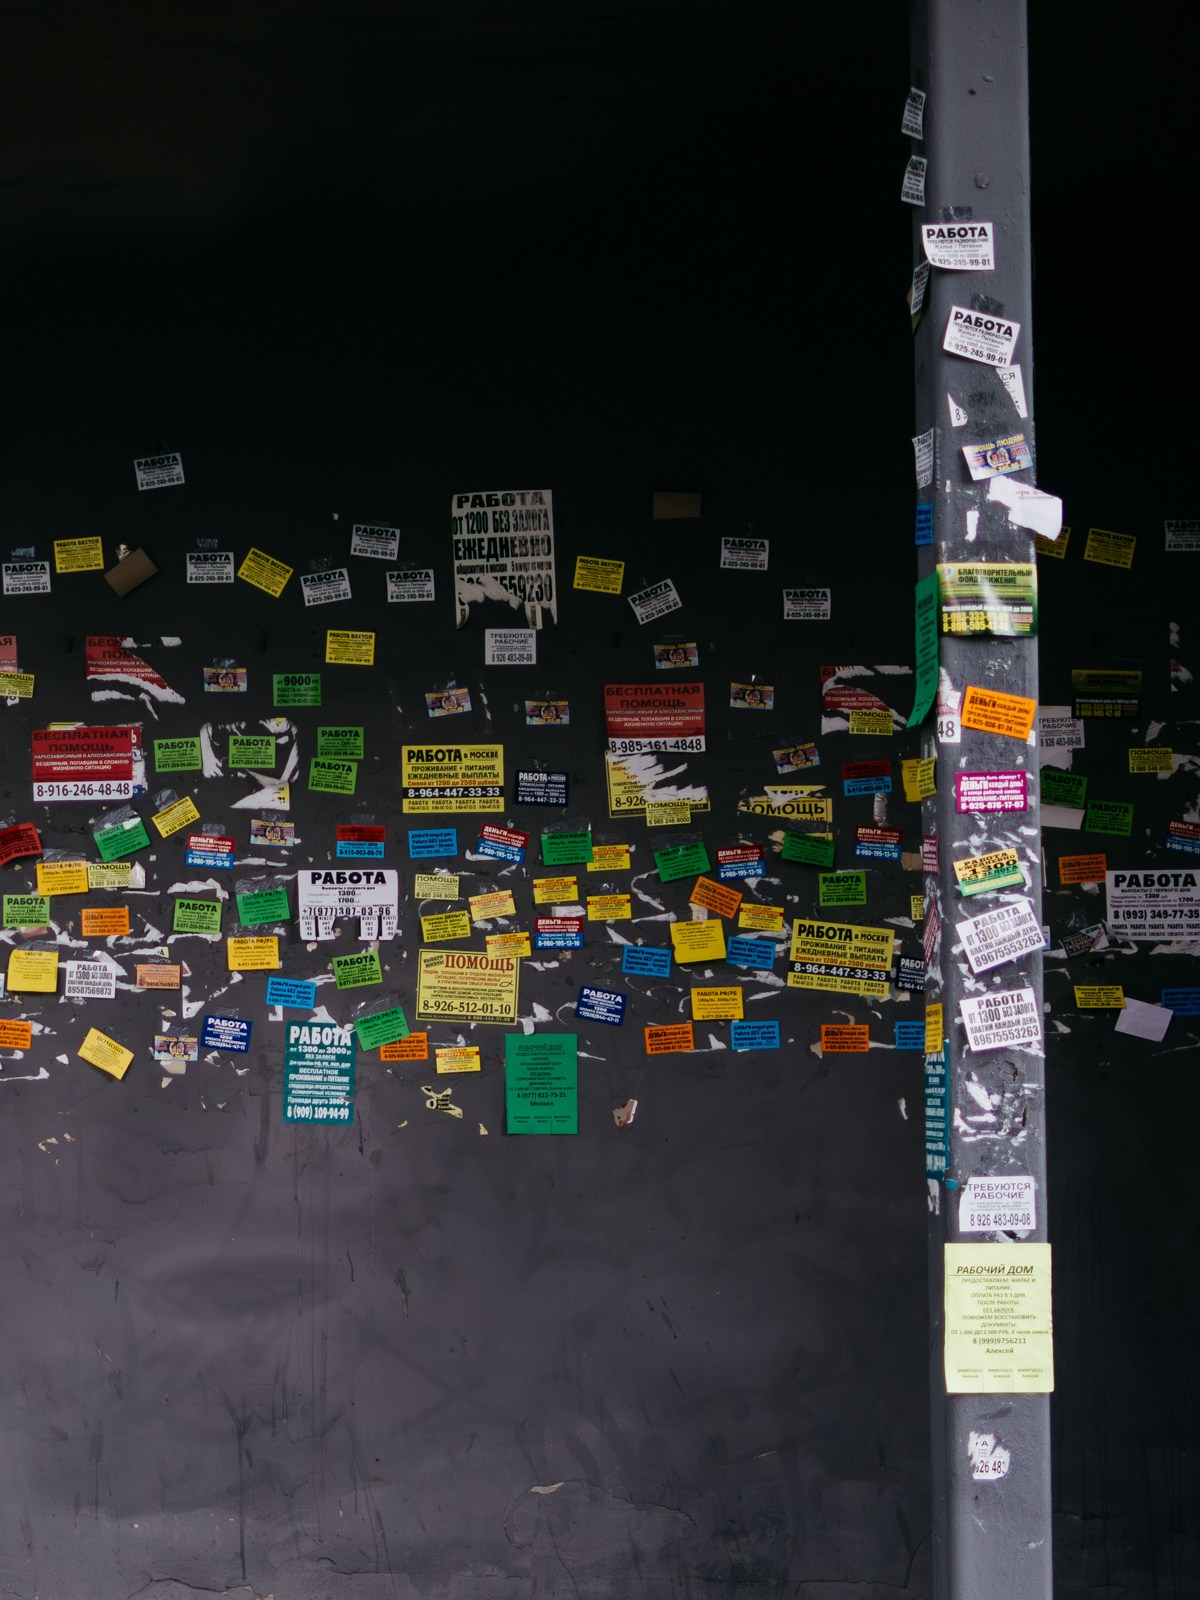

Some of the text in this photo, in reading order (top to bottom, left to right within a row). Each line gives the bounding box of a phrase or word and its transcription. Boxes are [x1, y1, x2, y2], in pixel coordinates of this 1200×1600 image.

[926, 226, 988, 238] РАБОТА
[954, 310, 1013, 337] РАБОТА
[457, 492, 545, 508] РАБОТА
[465, 509, 549, 534] 1200 БЕЗ ЗАЛОГА
[455, 534, 551, 562] ЕЖЕДНЕВНО
[958, 568, 1032, 576] БЛАГОТВОРИТЕЛЬНЫЙ
[284, 676, 311, 686] 9000
[606, 685, 700, 698] БЕСПЛАТНАЯ
[969, 695, 996, 708] ДЕНЬГИ
[34, 731, 128, 740] БЕСПЛАТНАЯ
[49, 744, 114, 752] ПОМОЩЬ
[158, 741, 196, 749] РАБОТА
[610, 738, 702, 754] 8-985-161-4848
[408, 749, 462, 762] РАБОТА
[519, 772, 547, 781] РАБОТА
[37, 783, 129, 797] 8-916-246-48-48
[408, 788, 500, 798] 8-964-447-33-33
[856, 849, 897, 857] 8-980-195-13-10
[968, 860, 1017, 875] 1300
[311, 872, 386, 884] РАБОТА
[1114, 874, 1197, 887] РАБОТА
[302, 906, 391, 916] +7(977)307-03-96
[1114, 910, 1199, 920] 8 (993) 349-77-35
[798, 924, 889, 943] РАБОТА МОСКВЕ
[974, 933, 1042, 967] 89675553263
[445, 954, 514, 972] ПОМОЩЬ
[794, 962, 887, 980] 8-964-447-33-33
[422, 1000, 510, 1014] 8-926-512-01-10
[978, 994, 1024, 1008] РАБОТА
[290, 1026, 351, 1046] РАБОТА
[974, 1026, 1039, 1047] 89675553263
[287, 1105, 349, 1119] 8 (909) 109-94-99
[968, 1182, 1031, 1191] ТРЕБУЮТСЯ
[974, 1191, 1024, 1199] РАБОЧИЕ
[970, 1213, 1031, 1226] 8 926 483-09-08
[957, 1265, 1033, 1275] РАБОЧИЙ ДОМ
[979, 1337, 1026, 1345] (999)9756211
[985, 1347, 1014, 1355] Алексей
